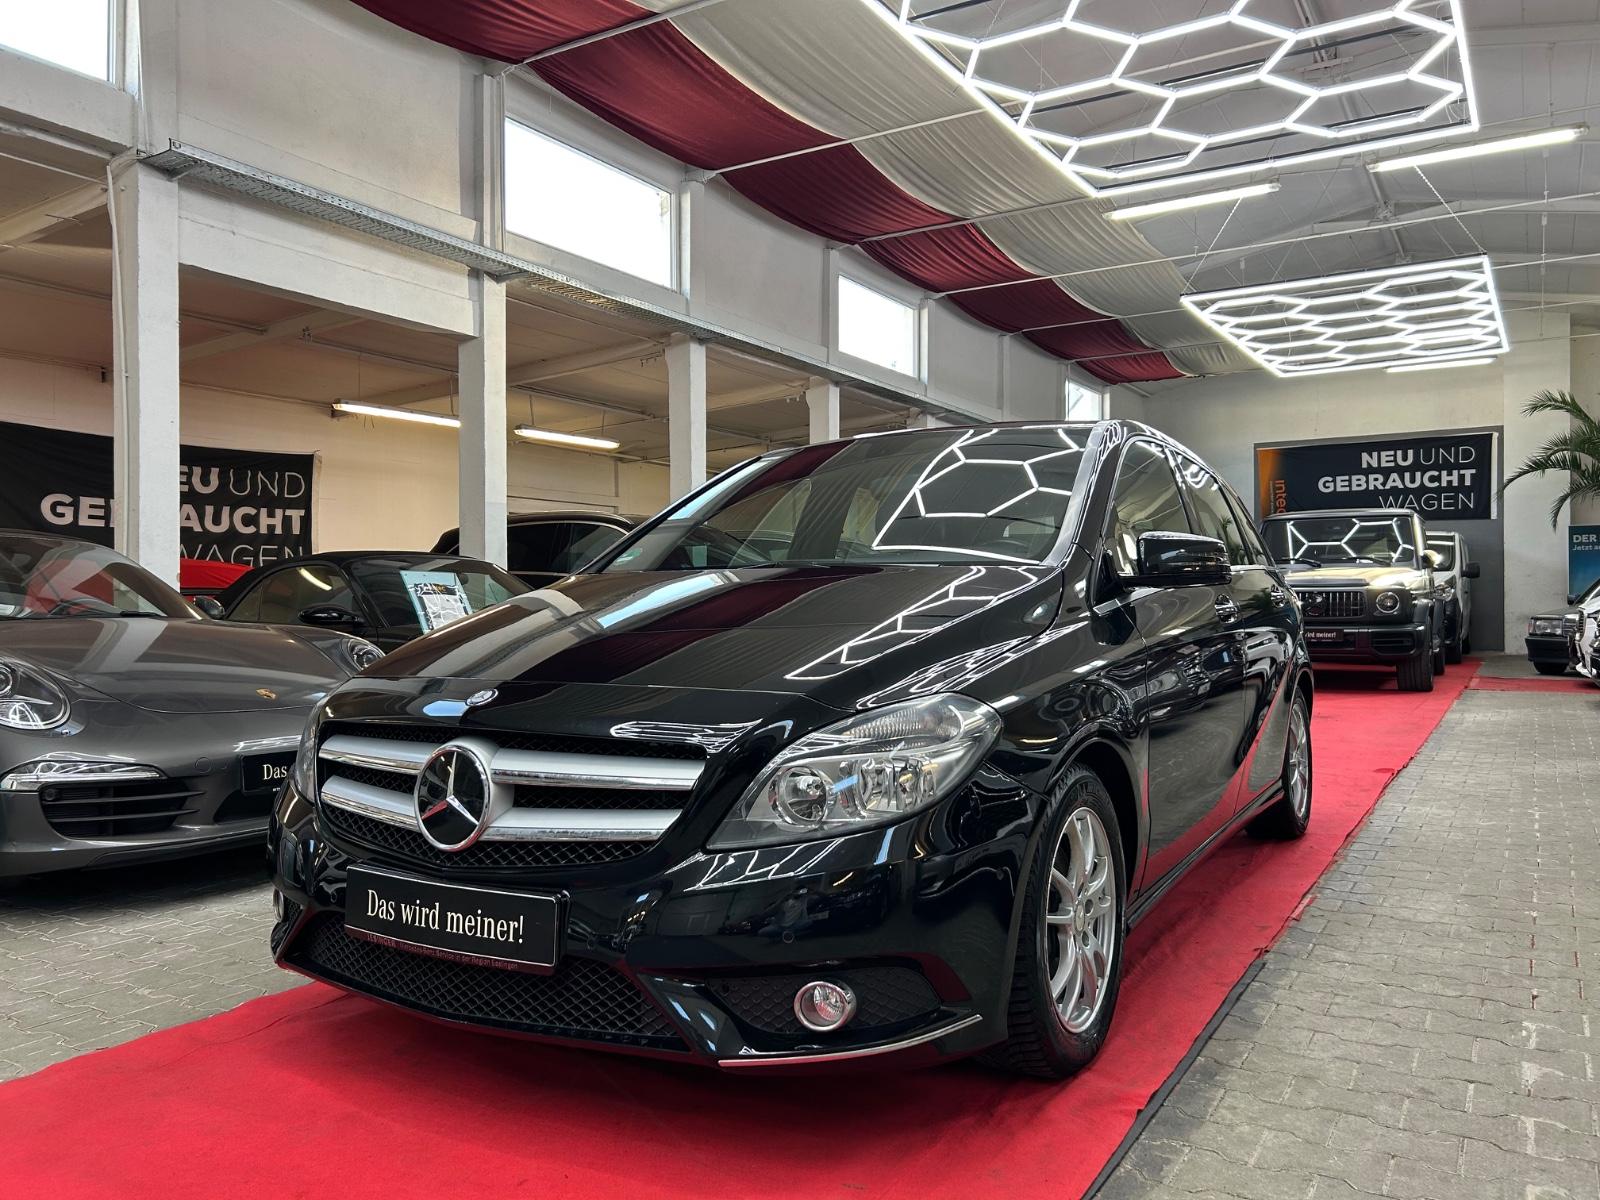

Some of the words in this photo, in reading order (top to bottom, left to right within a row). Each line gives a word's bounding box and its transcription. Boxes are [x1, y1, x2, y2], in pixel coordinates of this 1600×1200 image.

[1361, 449, 1413, 468] NEU
[1419, 446, 1475, 464] UND
[229, 469, 306, 498] UND
[1317, 469, 1476, 493] GEBRAUCHT
[1379, 492, 1474, 511] WAGEN
[1572, 534, 1597, 543] DER
[262, 763, 288, 780] Das
[367, 889, 395, 921] Das
[401, 899, 440, 930] wird
[446, 909, 524, 944] meiner!
